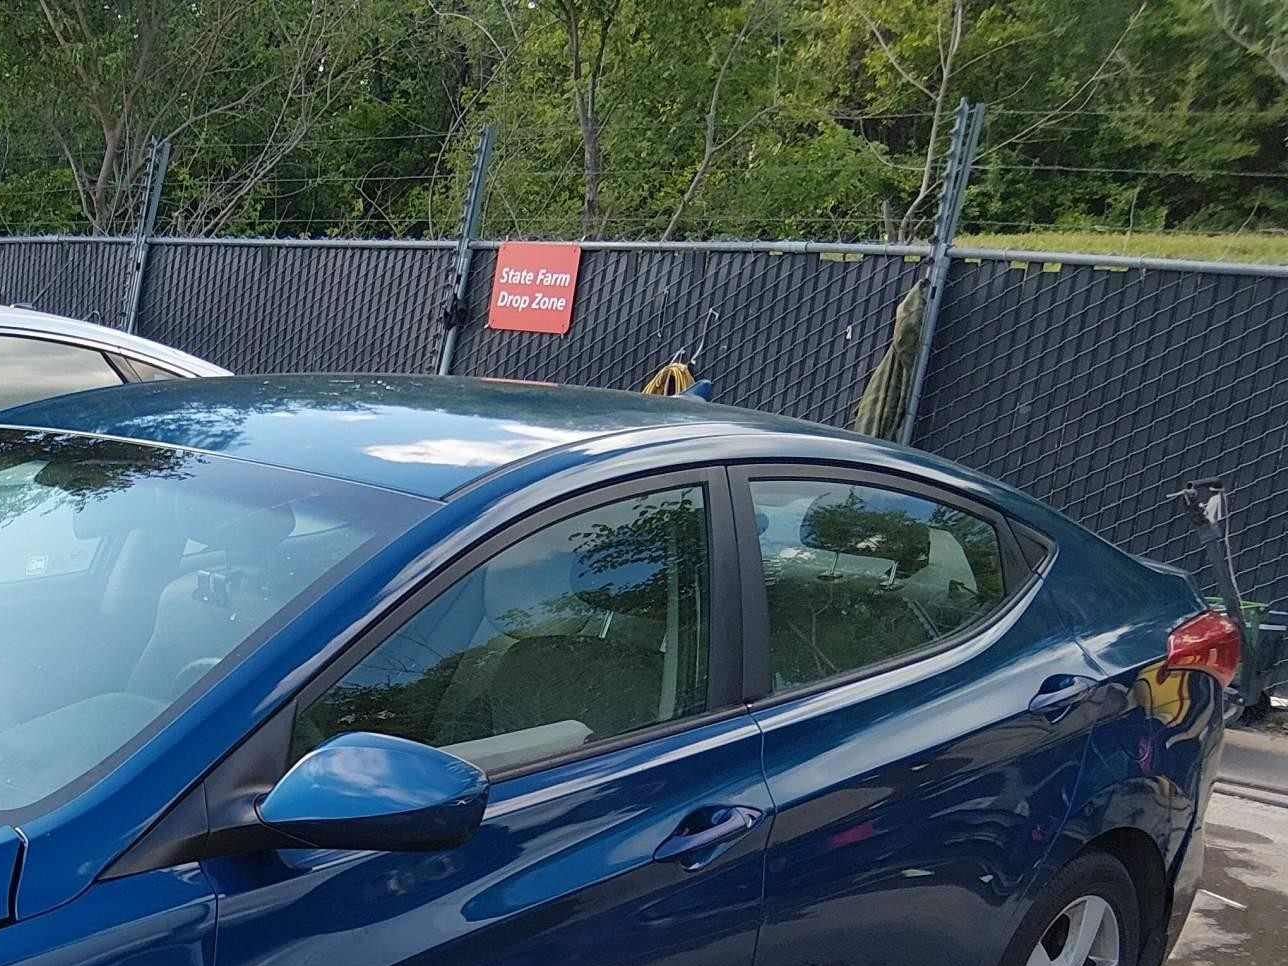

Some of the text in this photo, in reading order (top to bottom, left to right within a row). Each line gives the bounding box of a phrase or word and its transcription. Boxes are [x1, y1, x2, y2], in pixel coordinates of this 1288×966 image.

[499, 267, 571, 287] State Farm
[497, 291, 566, 312] Drop Zone
